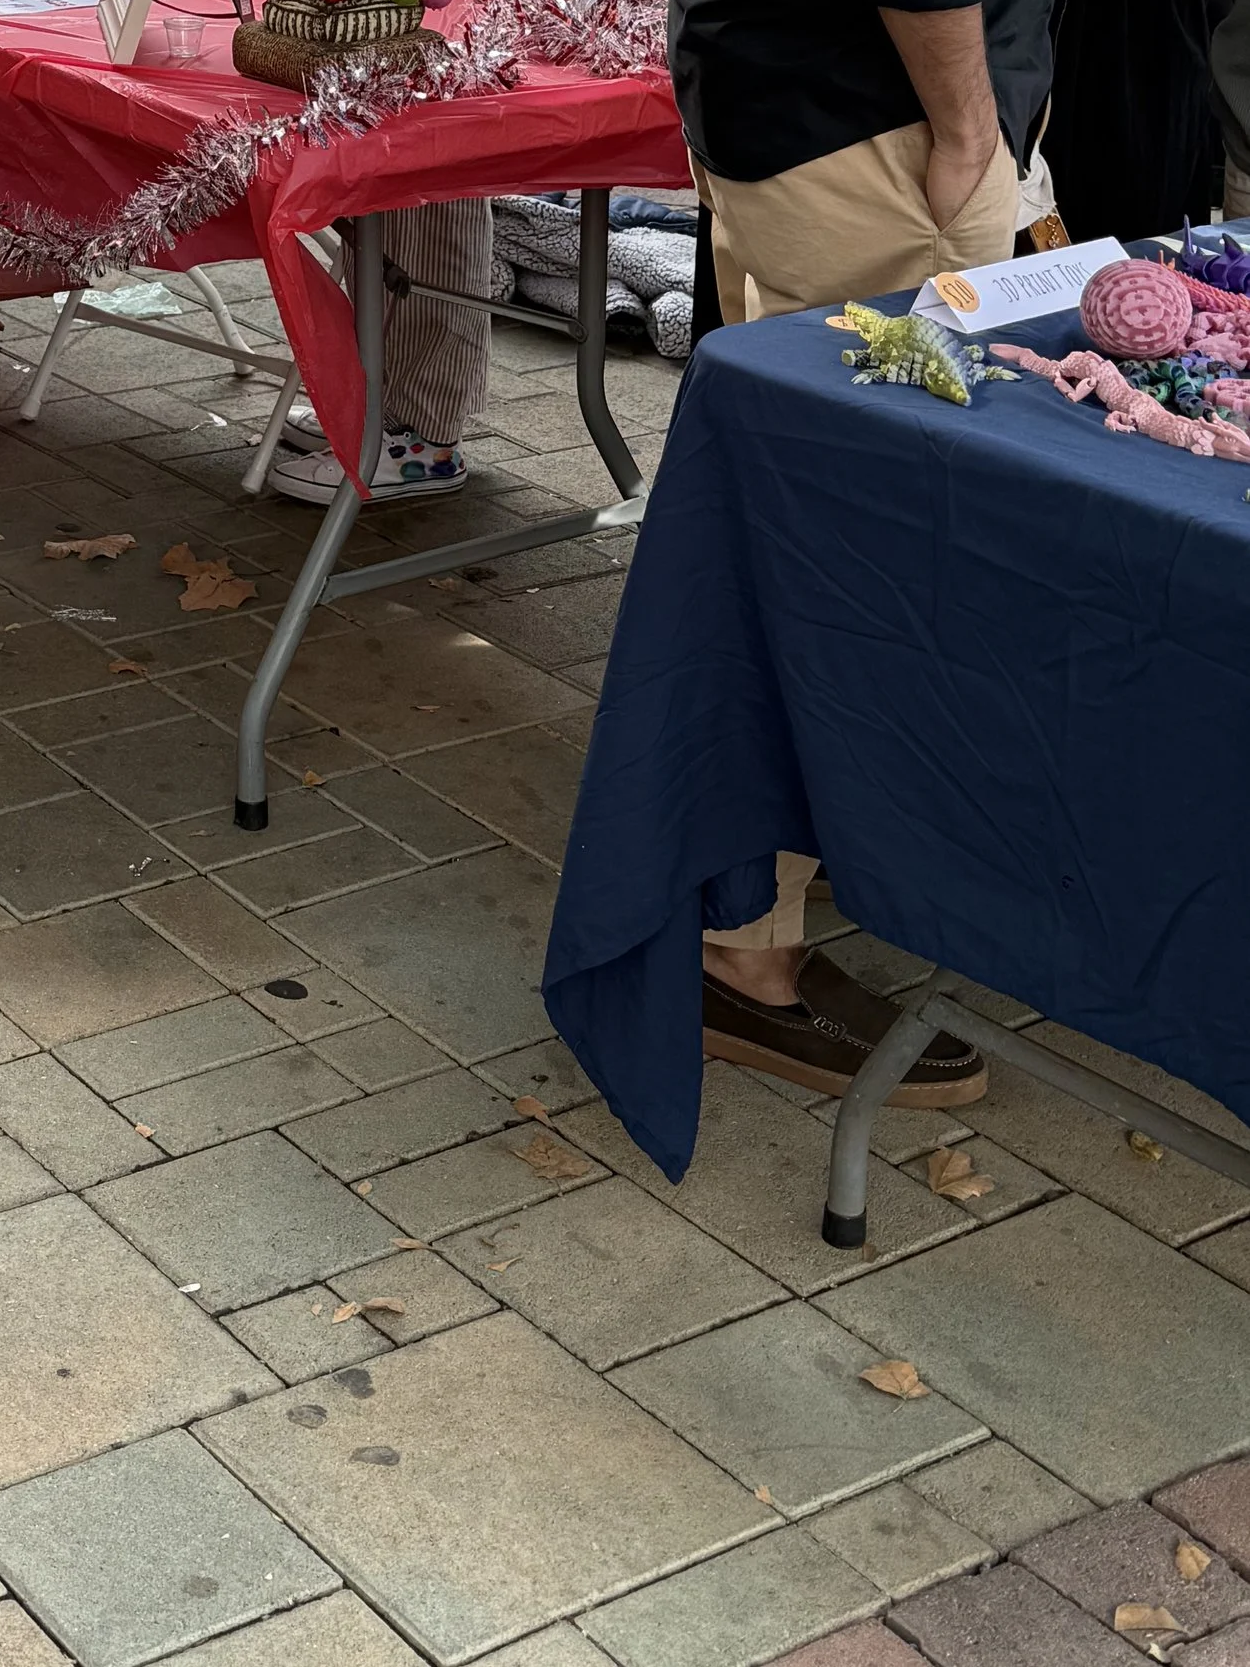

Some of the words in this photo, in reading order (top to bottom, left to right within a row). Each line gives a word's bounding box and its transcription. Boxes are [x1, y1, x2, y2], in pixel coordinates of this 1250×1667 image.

[942, 279, 975, 309] $10
[992, 277, 1020, 303] 3D
[1014, 269, 1063, 299] PRINT
